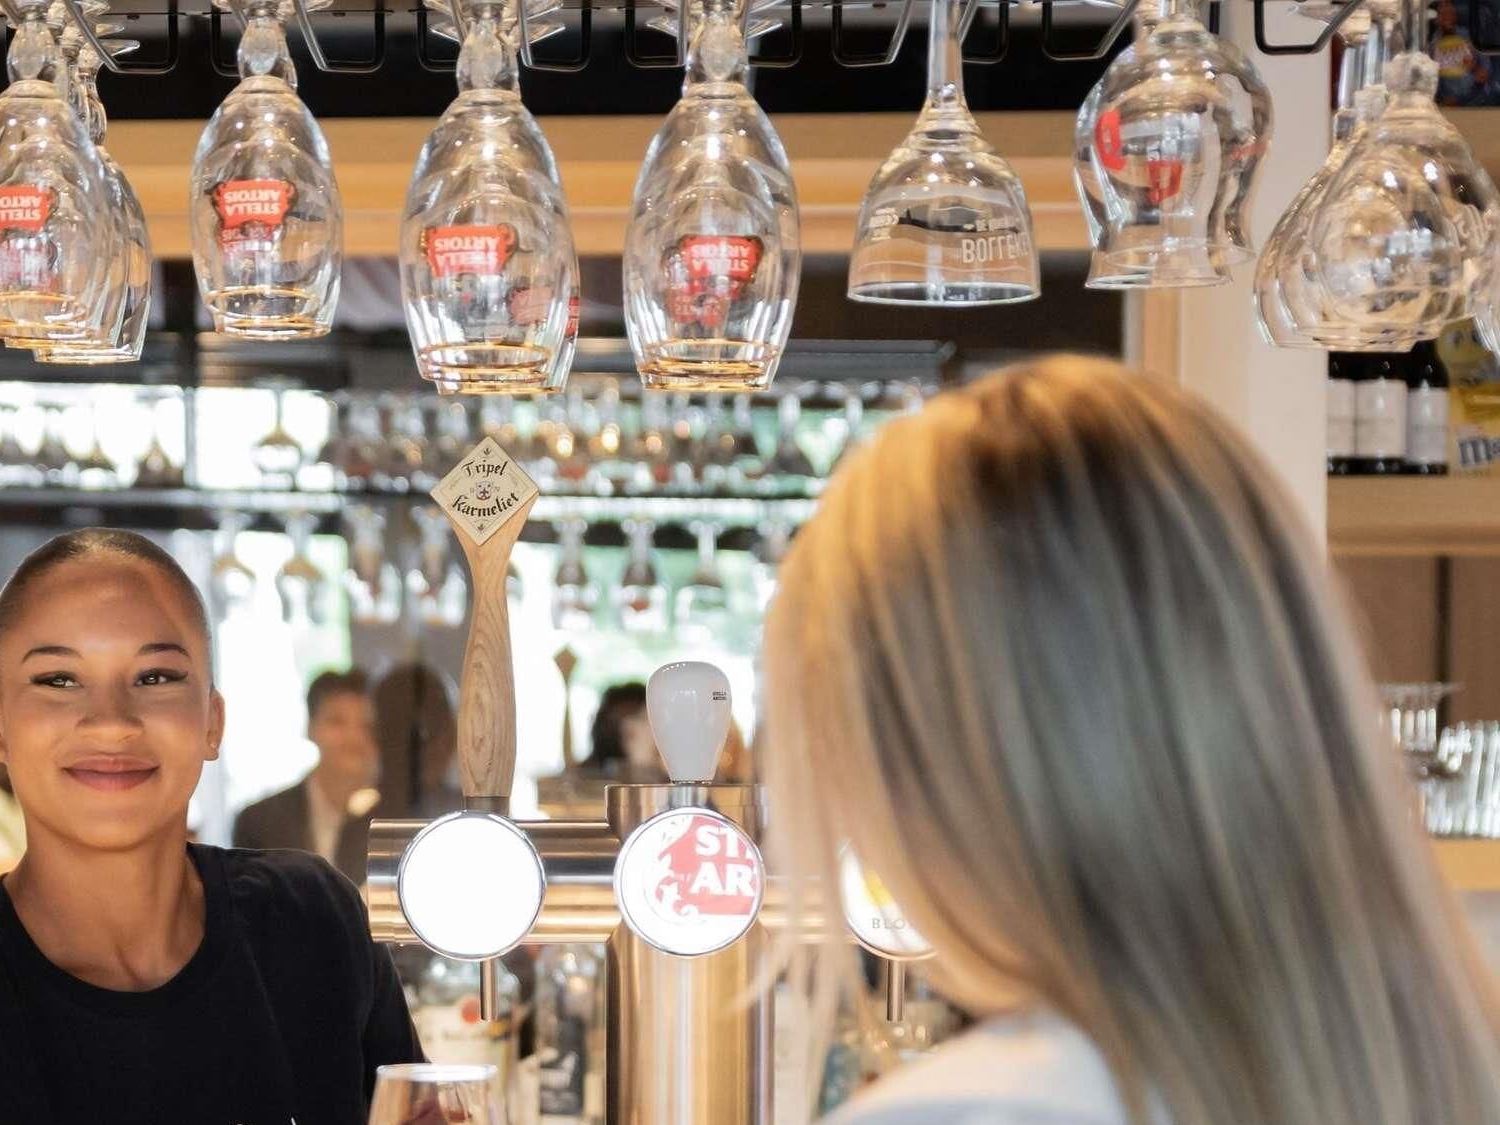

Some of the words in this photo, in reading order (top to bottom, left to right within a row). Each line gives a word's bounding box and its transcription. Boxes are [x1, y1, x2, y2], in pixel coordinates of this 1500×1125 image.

[224, 189, 280, 203] ARTOIS
[225, 203, 280, 216] STELLA
[434, 237, 500, 252] ARTOIS
[461, 459, 508, 477] Tripel
[452, 493, 519, 517] Karmeliet
[690, 861, 756, 896] AR
[871, 918, 907, 930] BLO
